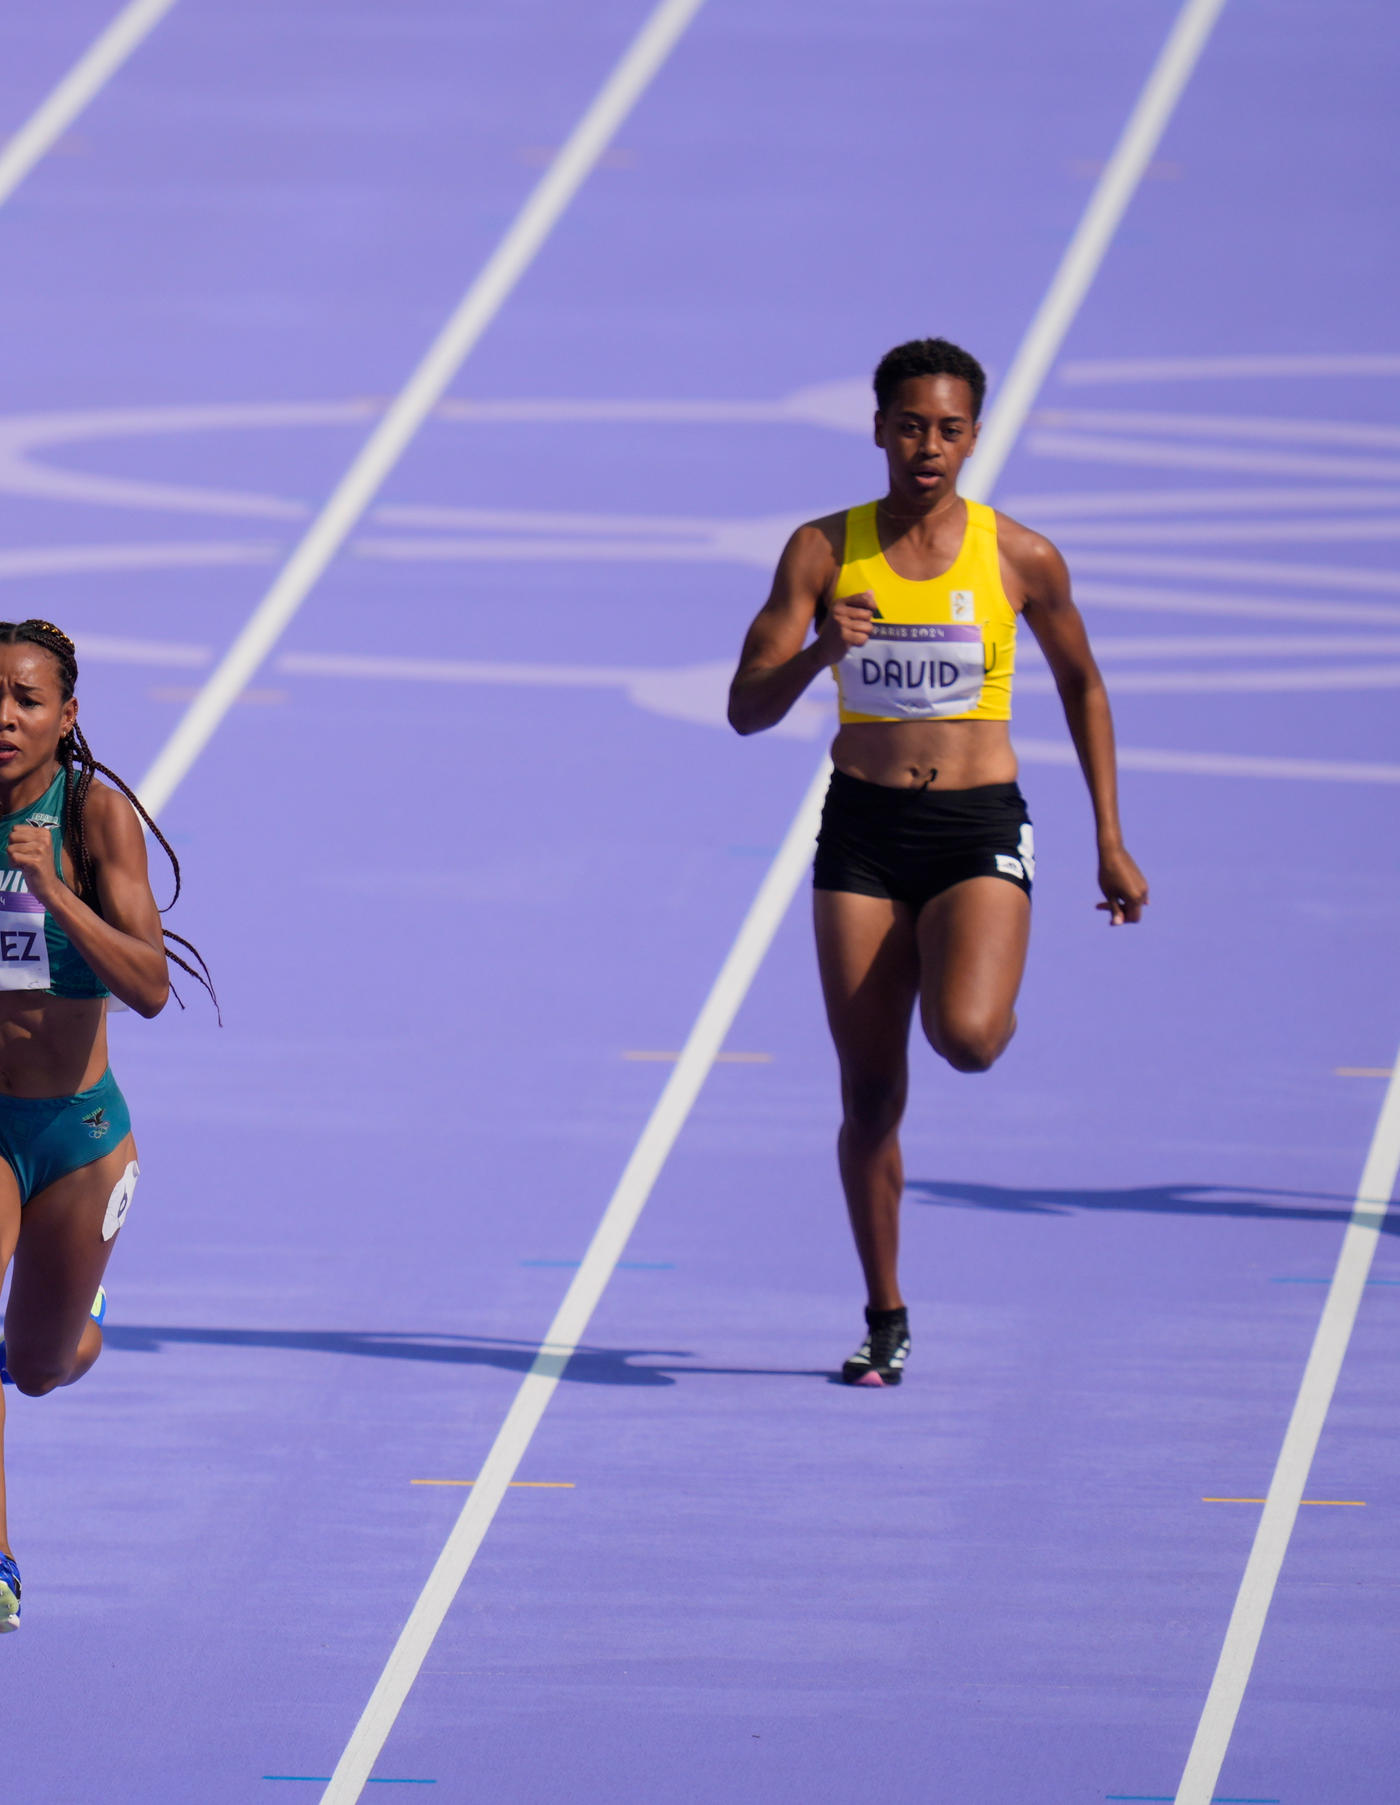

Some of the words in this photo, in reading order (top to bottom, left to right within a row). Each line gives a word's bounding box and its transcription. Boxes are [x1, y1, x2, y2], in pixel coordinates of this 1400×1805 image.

[872, 626, 909, 638] PARIS
[911, 627, 945, 638] 2024
[861, 657, 960, 689] DAVID
